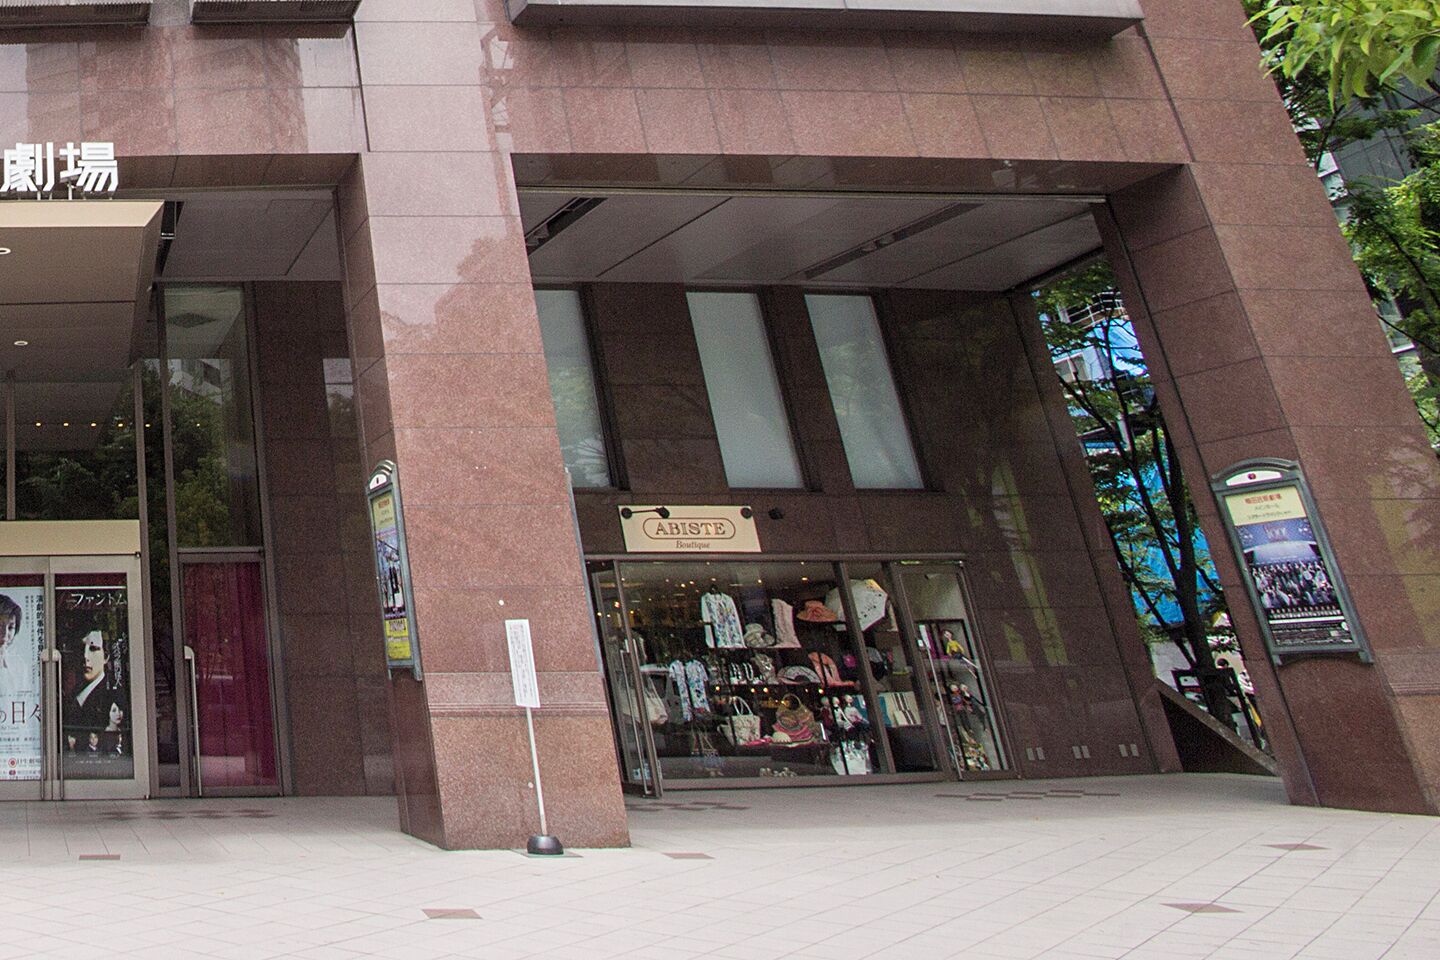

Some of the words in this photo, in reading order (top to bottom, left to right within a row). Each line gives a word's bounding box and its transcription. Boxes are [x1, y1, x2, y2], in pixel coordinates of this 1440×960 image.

[655, 522, 726, 536] ABISTE
[675, 540, 711, 551] Boutique
[70, 592, 128, 607] ファントム
